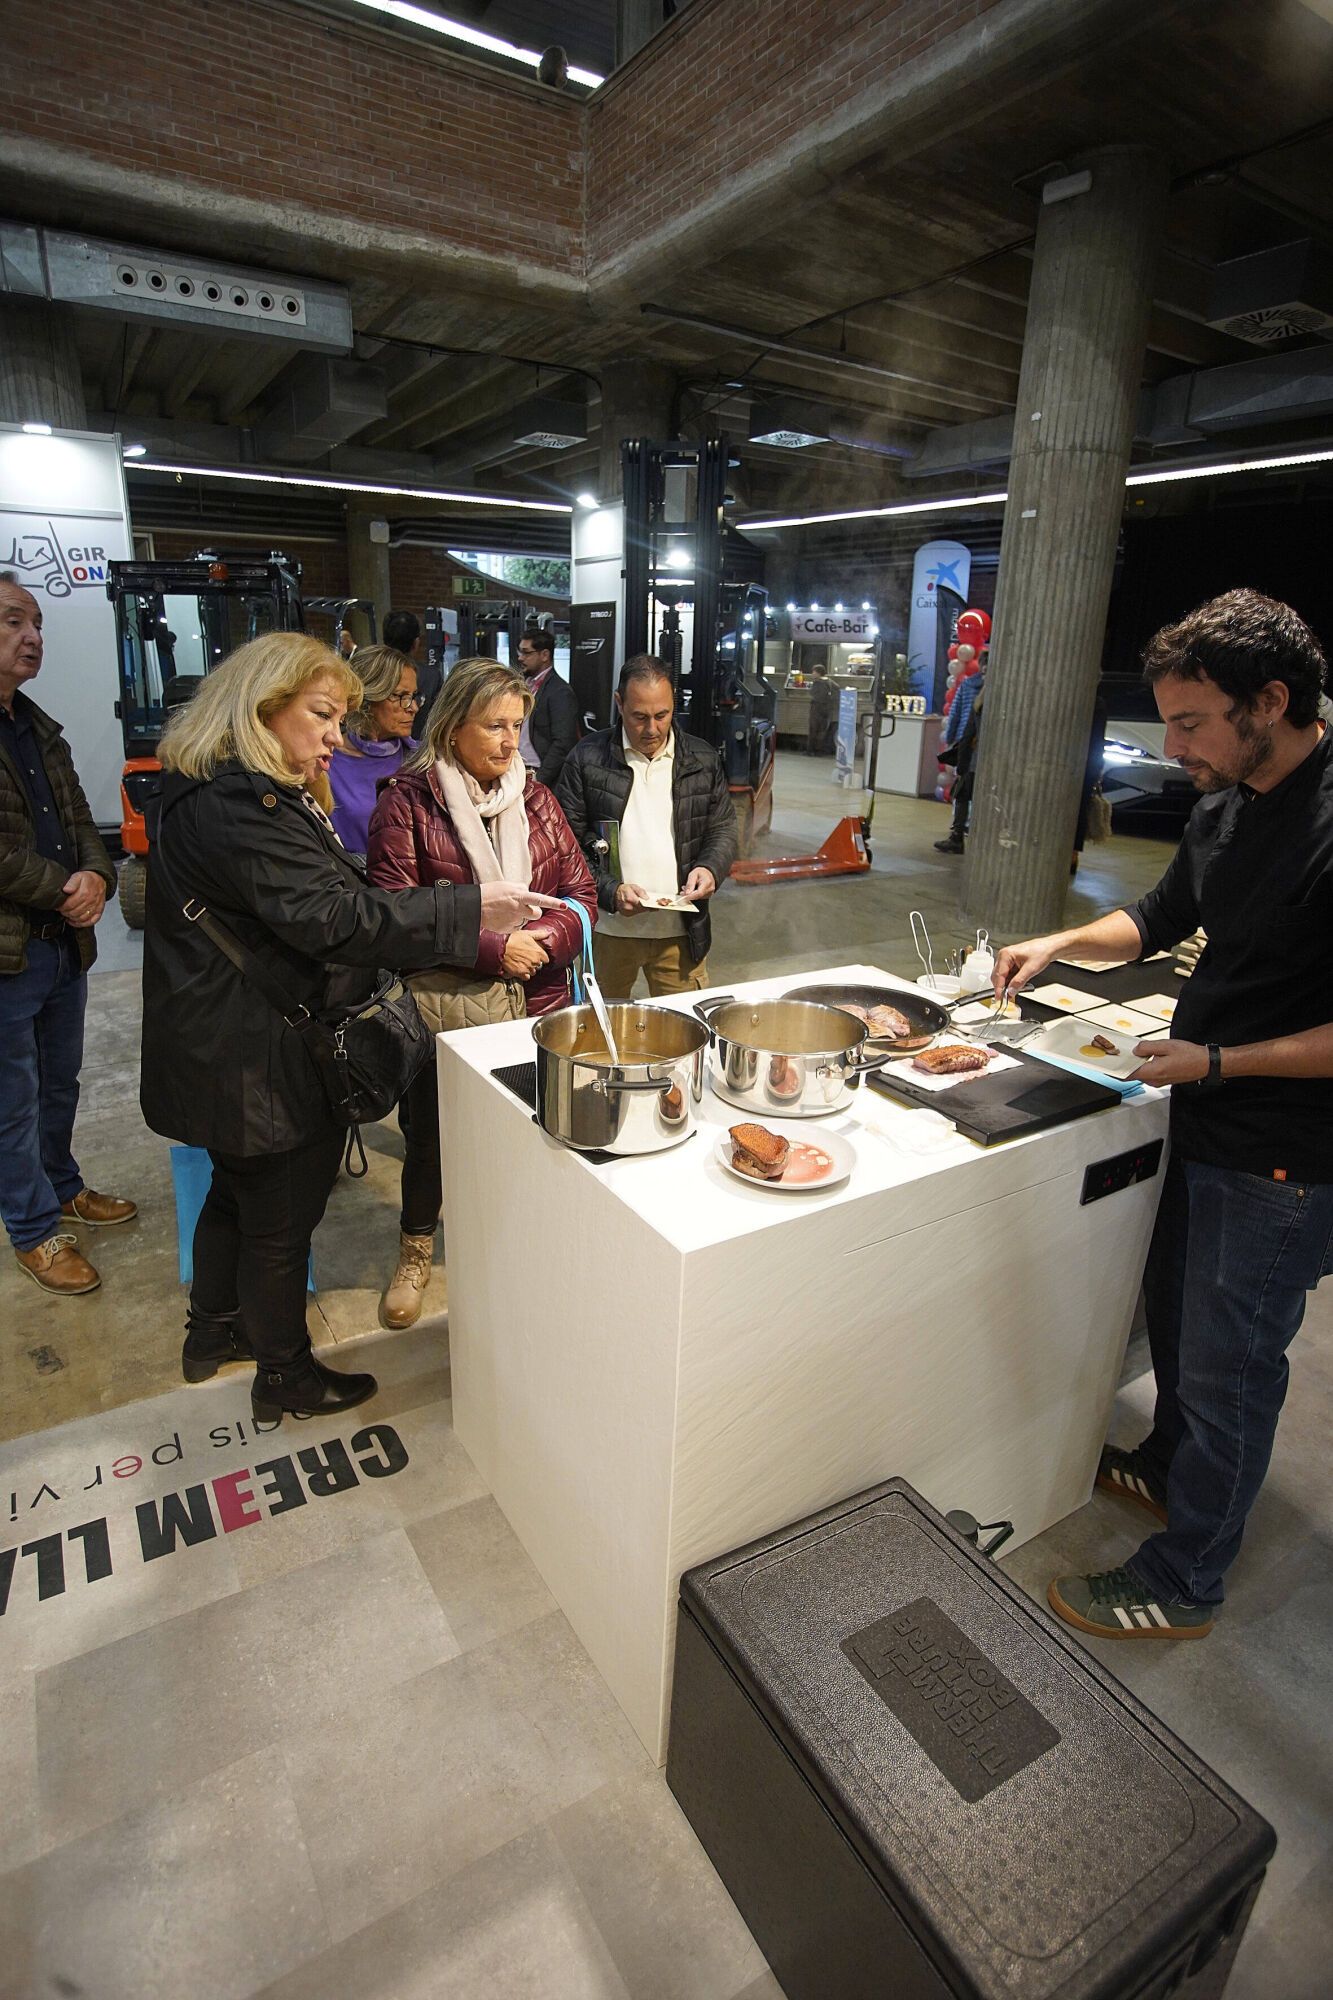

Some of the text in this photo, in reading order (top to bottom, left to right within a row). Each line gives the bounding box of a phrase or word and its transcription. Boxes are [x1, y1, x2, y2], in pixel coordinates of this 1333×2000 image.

[67, 547, 107, 562] GIR
[83, 1432, 183, 1491] per
[9, 1483, 61, 1522] vi
[893, 1616, 998, 1724] FUTURE
[947, 1640, 1020, 1710] BOX
